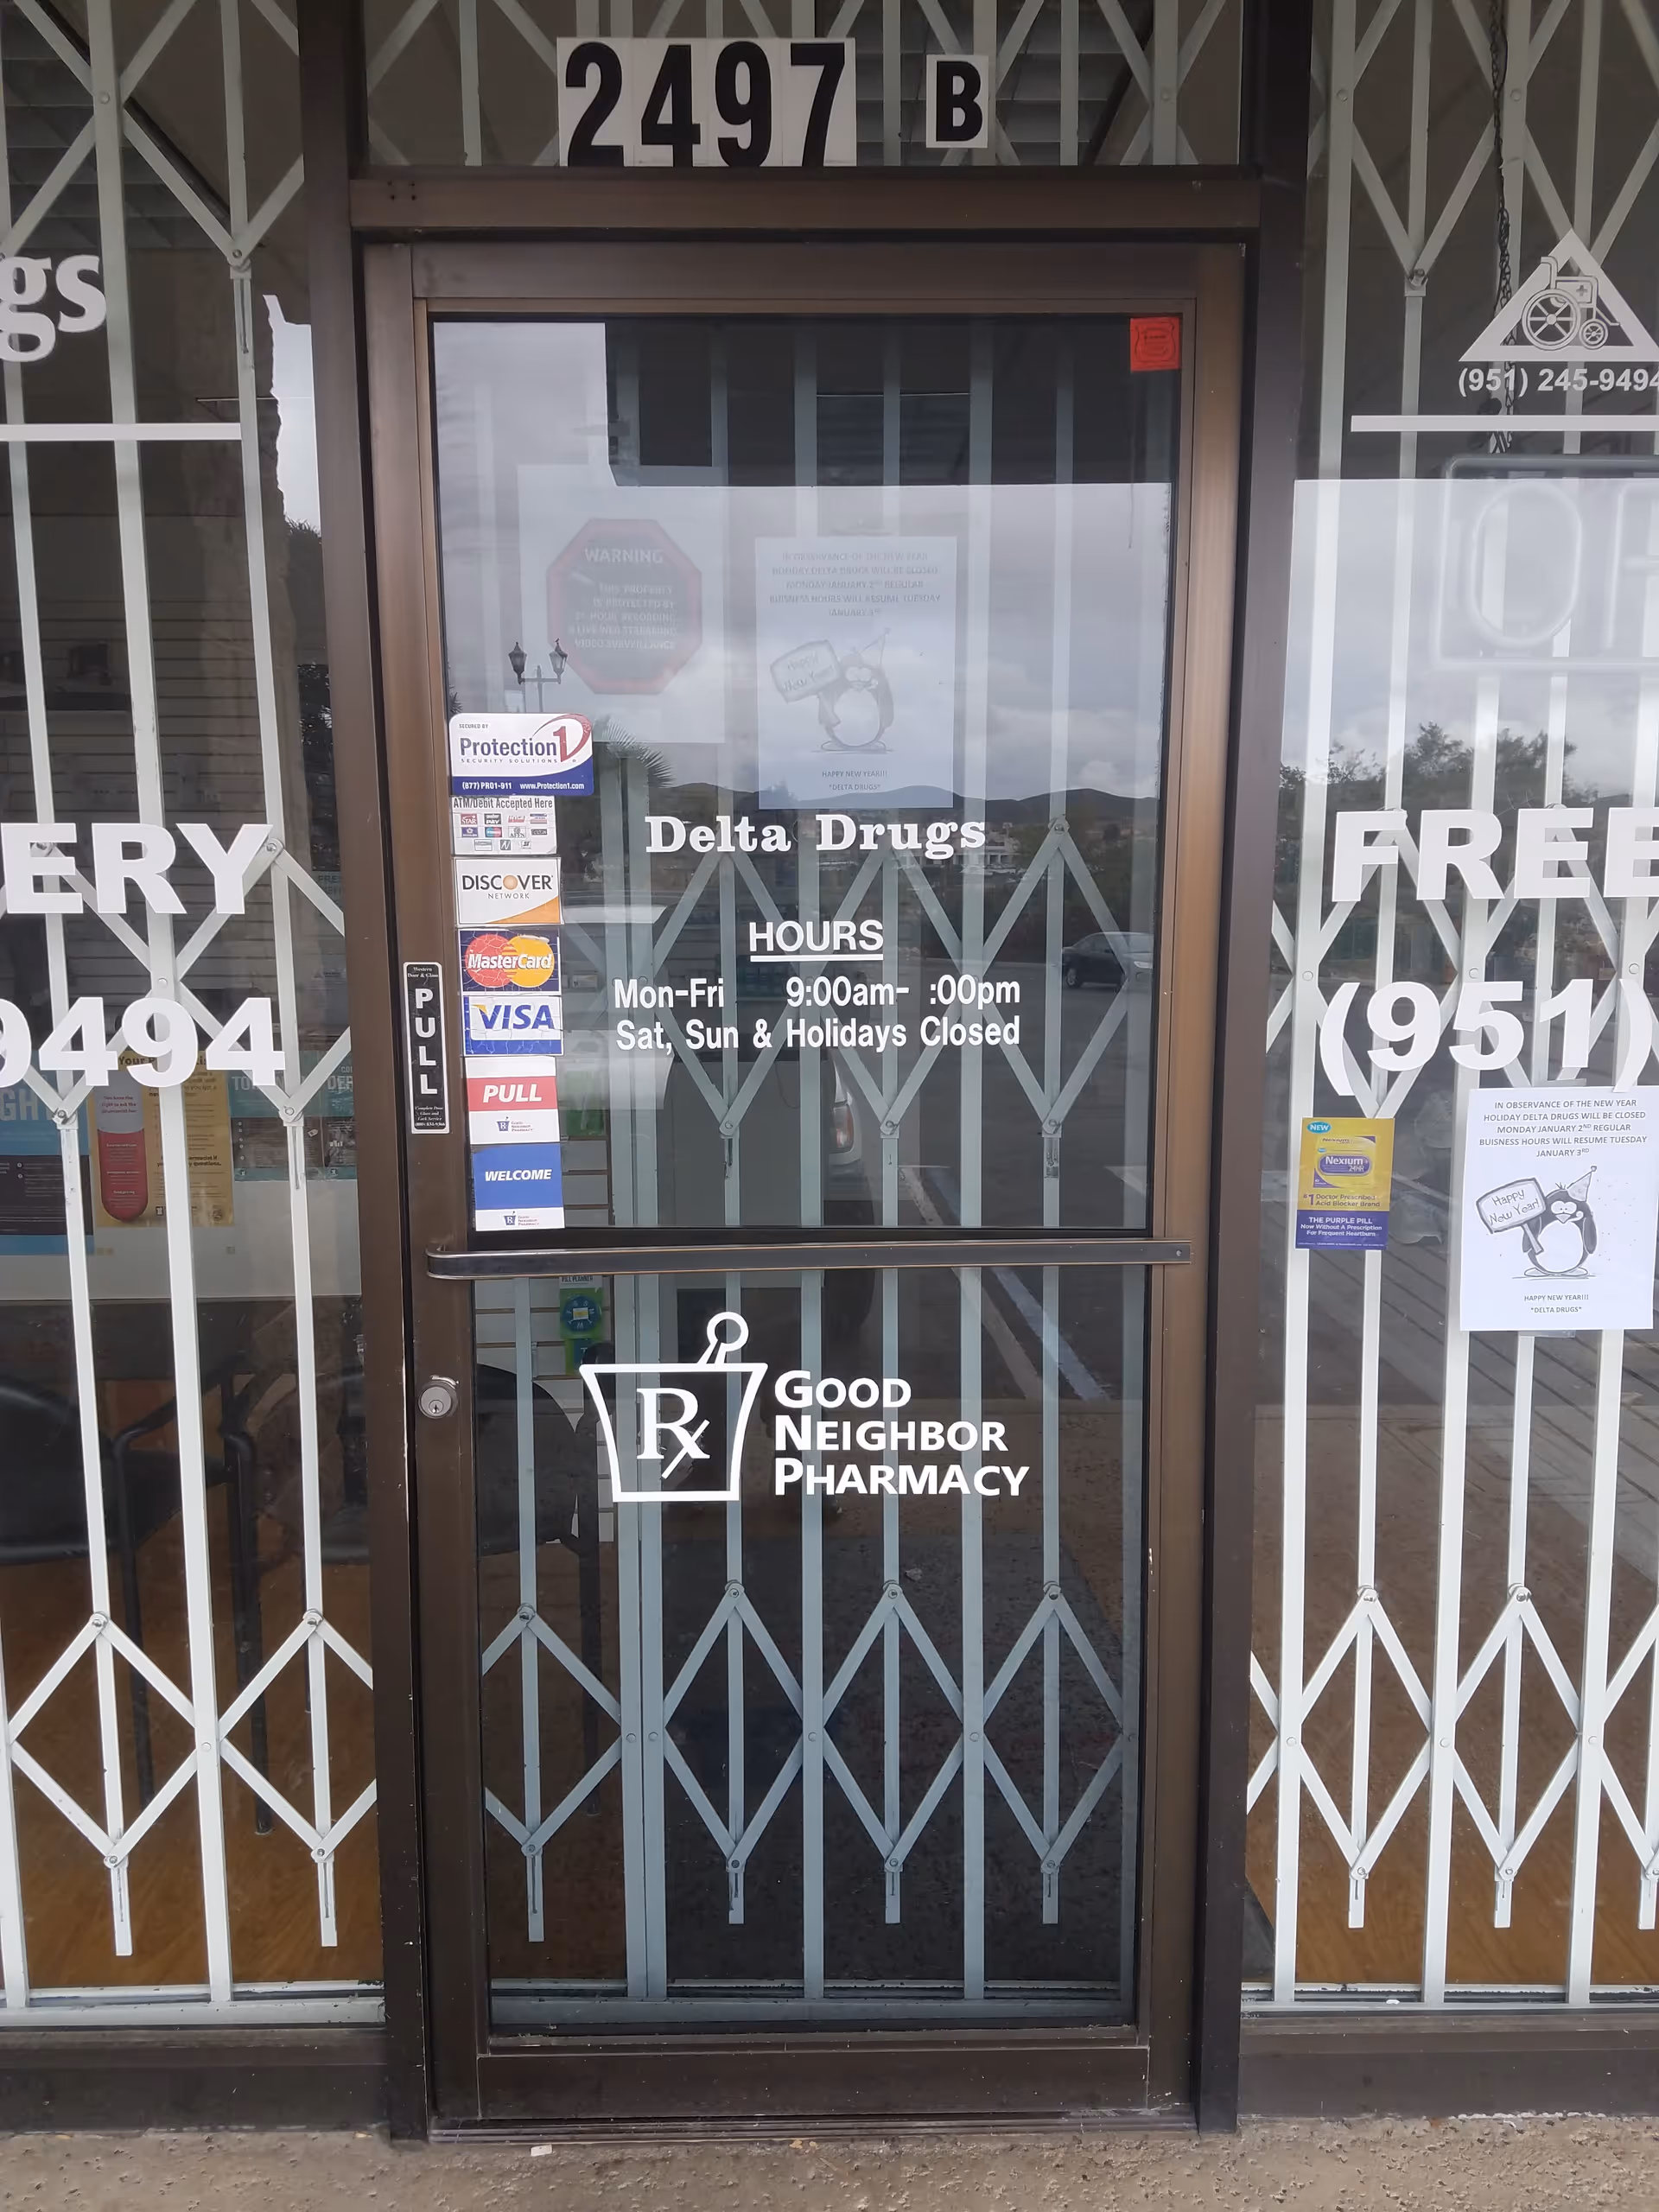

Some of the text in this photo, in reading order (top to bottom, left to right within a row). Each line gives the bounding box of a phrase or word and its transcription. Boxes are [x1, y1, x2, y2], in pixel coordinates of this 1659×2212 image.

[565, 41, 845, 167] 2497
[936, 60, 983, 141] B
[1459, 368, 1528, 397] (951)
[584, 548, 664, 563] WARNING
[460, 737, 557, 757] Protection
[462, 781, 480, 790] (877)
[454, 797, 553, 810] ATM/Debit Accepted Here
[645, 814, 986, 859] Delta Drugs
[1, 823, 273, 914] ERY
[1332, 807, 1659, 903] FREE
[462, 874, 553, 891] DISCOVER
[749, 919, 885, 951] HOURS
[467, 953, 553, 969] MasterCard
[614, 978, 725, 1008] Mon-Fri
[930, 974, 1020, 1009] :00pm
[472, 1004, 555, 1030] VISA
[415, 988, 438, 1095] PULL
[616, 1015, 1020, 1055] Sat, Sun & Holidays Closed
[1319, 978, 1653, 1096] (951)
[483, 1084, 543, 1103] PULL
[1505, 1101, 1560, 1109] OBSERVANCE
[1479, 1138, 1520, 1147] BUISNESS
[1521, 1137, 1550, 1146] HOURS
[1552, 1136, 1572, 1145] WILL
[1610, 1135, 1647, 1144] TUESDAY
[1593, 1123, 1631, 1132] REGULAR
[1325, 1156, 1363, 1166] Nexium
[485, 1169, 552, 1182] WELCOME
[1489, 1198, 1540, 1226] New Year!
[1491, 1189, 1524, 1207] Happy
[775, 1370, 912, 1408] GOOD
[775, 1414, 1008, 1452] NEIGHBOR
[775, 1457, 1029, 1496] PHARMACY
